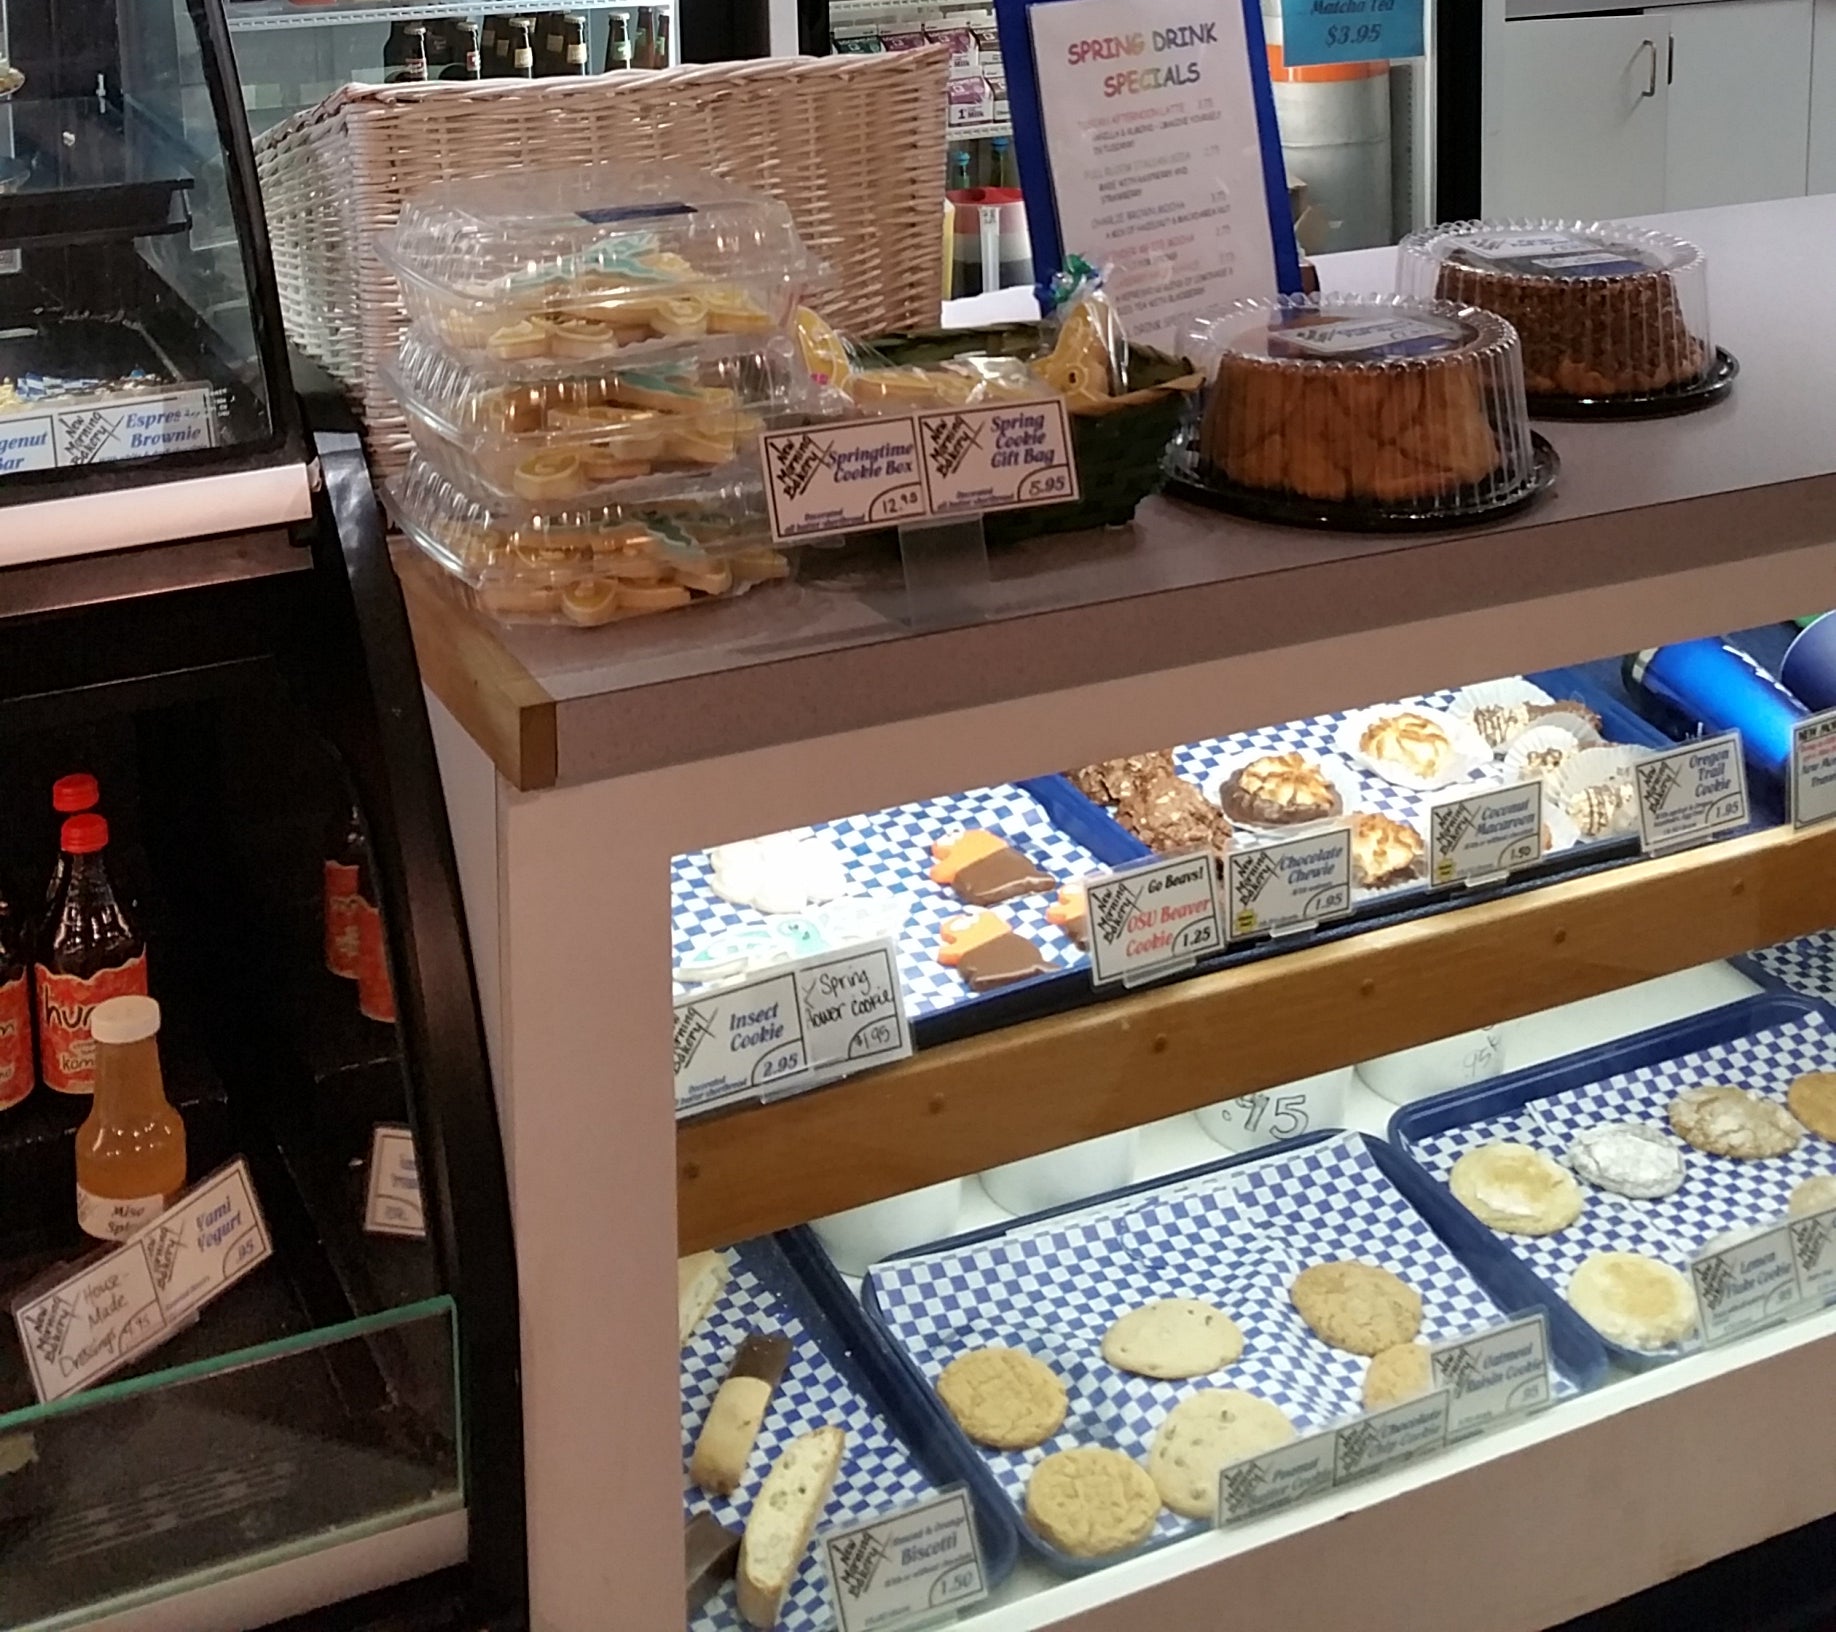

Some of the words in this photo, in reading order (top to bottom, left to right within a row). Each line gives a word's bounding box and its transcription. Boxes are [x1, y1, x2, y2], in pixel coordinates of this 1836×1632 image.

[1311, 0, 1366, 15] Matcha
[1067, 32, 1145, 66] SPRING
[1153, 22, 1218, 52] DRINK
[1326, 24, 1382, 46] $3.95
[1104, 62, 1200, 98] SPECIALS
[991, 412, 1045, 434] Spring
[131, 428, 201, 449] Brownie
[996, 431, 1046, 450] Cookie
[828, 442, 913, 466] Springtime
[991, 450, 1020, 469] Gift
[1024, 447, 1054, 466] Bag
[834, 465, 880, 484] Cookie
[886, 460, 912, 478] Box
[1029, 476, 1065, 496] 5.95
[1716, 802, 1738, 818] 1.95
[1280, 845, 1343, 871] Chocolate
[1148, 879, 1163, 894] Go
[1166, 866, 1204, 890] Beavs!
[1127, 908, 1158, 934] OSU
[1160, 898, 1210, 923] Beaver
[1126, 930, 1174, 958] Cookie
[1182, 926, 1212, 948] 1.25
[820, 969, 870, 997] Spring
[730, 1002, 779, 1031] Insect
[730, 1023, 784, 1052] Cookie
[763, 1052, 798, 1078] 2.95
